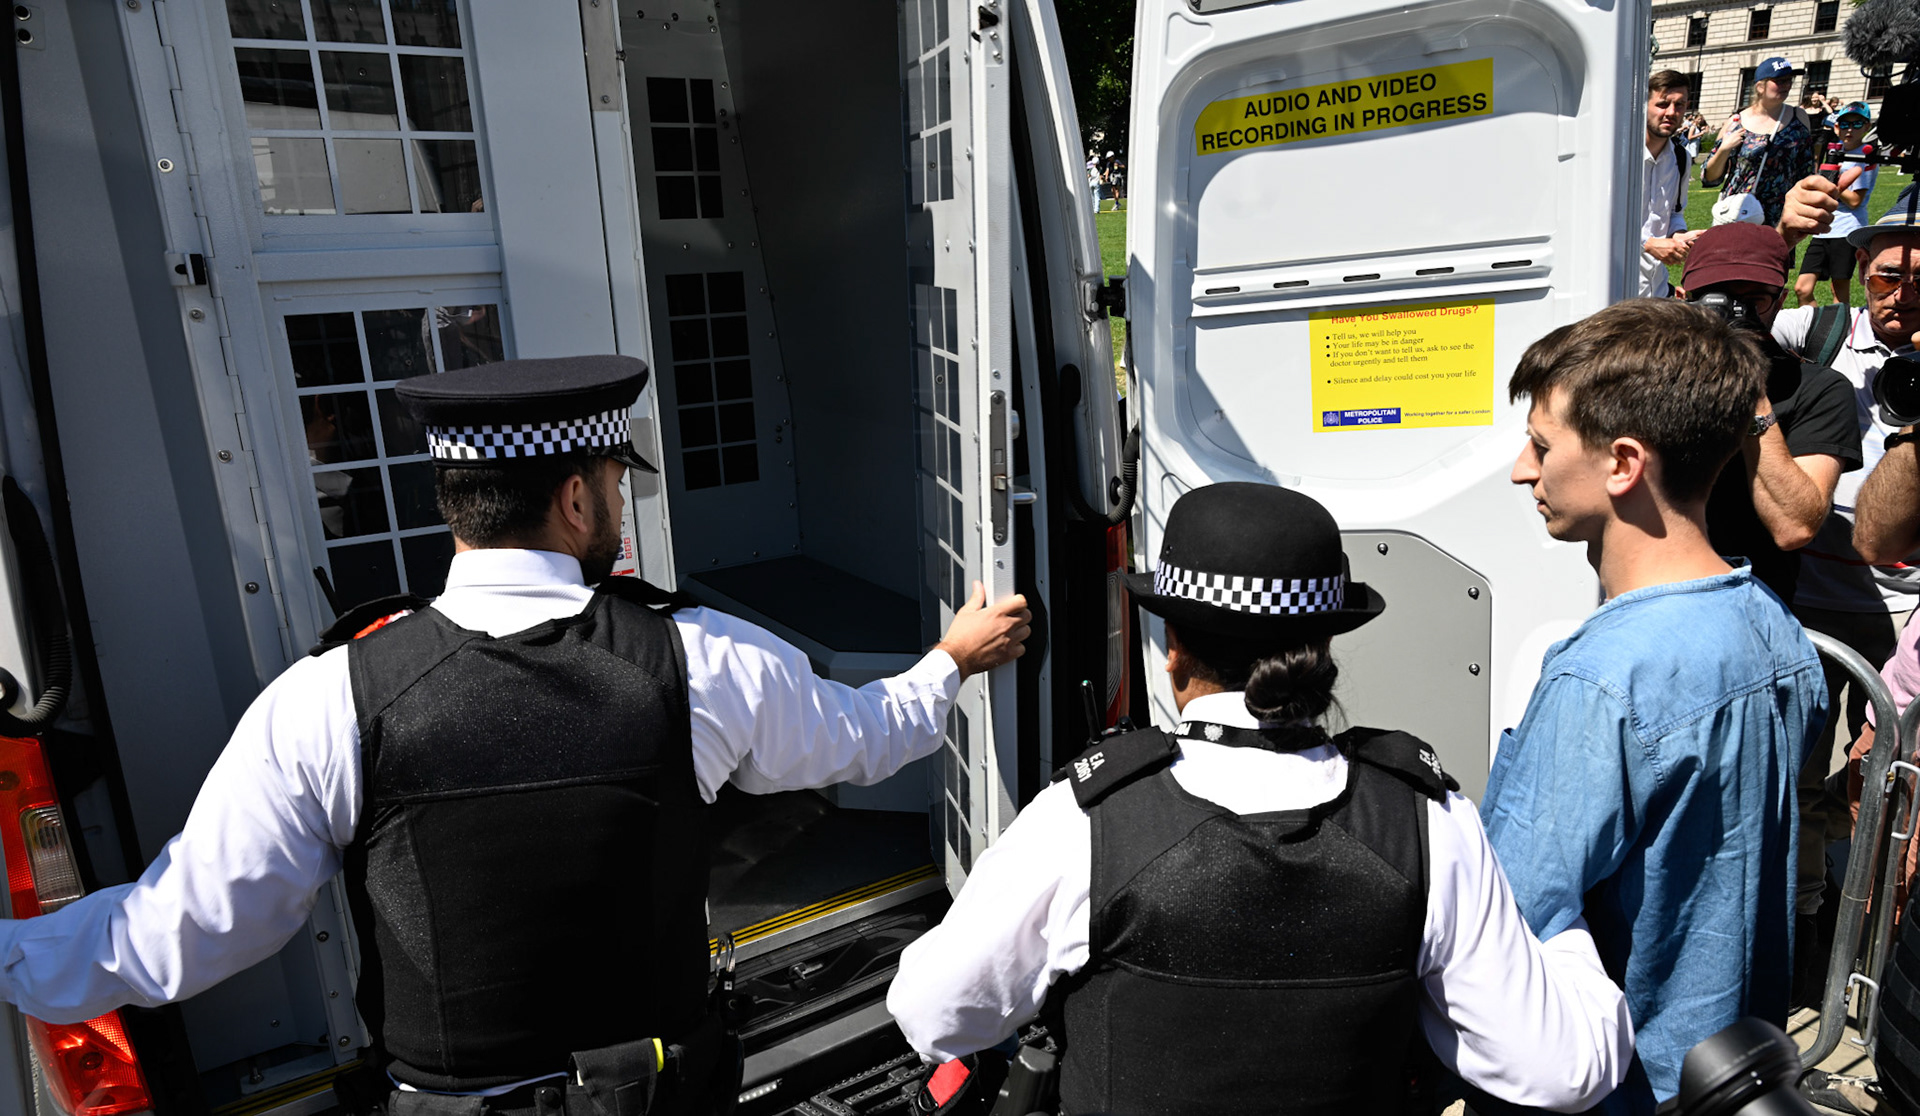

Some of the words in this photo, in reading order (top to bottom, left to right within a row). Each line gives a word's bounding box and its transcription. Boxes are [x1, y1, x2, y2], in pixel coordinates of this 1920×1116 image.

[1244, 92, 1310, 119] AUDIO
[1316, 84, 1362, 108] AND
[1368, 72, 1437, 99] VIDEO
[1201, 116, 1327, 151] RECORDING
[1334, 111, 1355, 131] IN
[1362, 92, 1487, 127] PROGRESS
[1331, 315, 1356, 324] Have
[1359, 313, 1379, 322] You
[1381, 307, 1437, 320] Swallowed
[1440, 304, 1479, 317] Drugs?
[1332, 333, 1346, 341] Tell
[1371, 329, 1385, 337] will
[1386, 329, 1401, 337] help
[1403, 329, 1416, 337] you
[1352, 340, 1363, 348] life
[1400, 337, 1424, 345] danger
[1354, 348, 1373, 357] don't
[1426, 344, 1439, 352] ask
[1463, 342, 1475, 350] the
[1353, 358, 1381, 367] urgently
[1383, 356, 1396, 364] and
[1410, 354, 1428, 362] them
[1333, 377, 1358, 385] Silence
[1360, 375, 1372, 383] and
[1373, 374, 1392, 383] delay
[1393, 373, 1413, 381] could
[1446, 371, 1462, 379] your
[1464, 369, 1476, 377] life
[1344, 409, 1397, 418] METROPOLITAN
[1357, 416, 1383, 424] POLICE
[1089, 751, 1105, 771] EA
